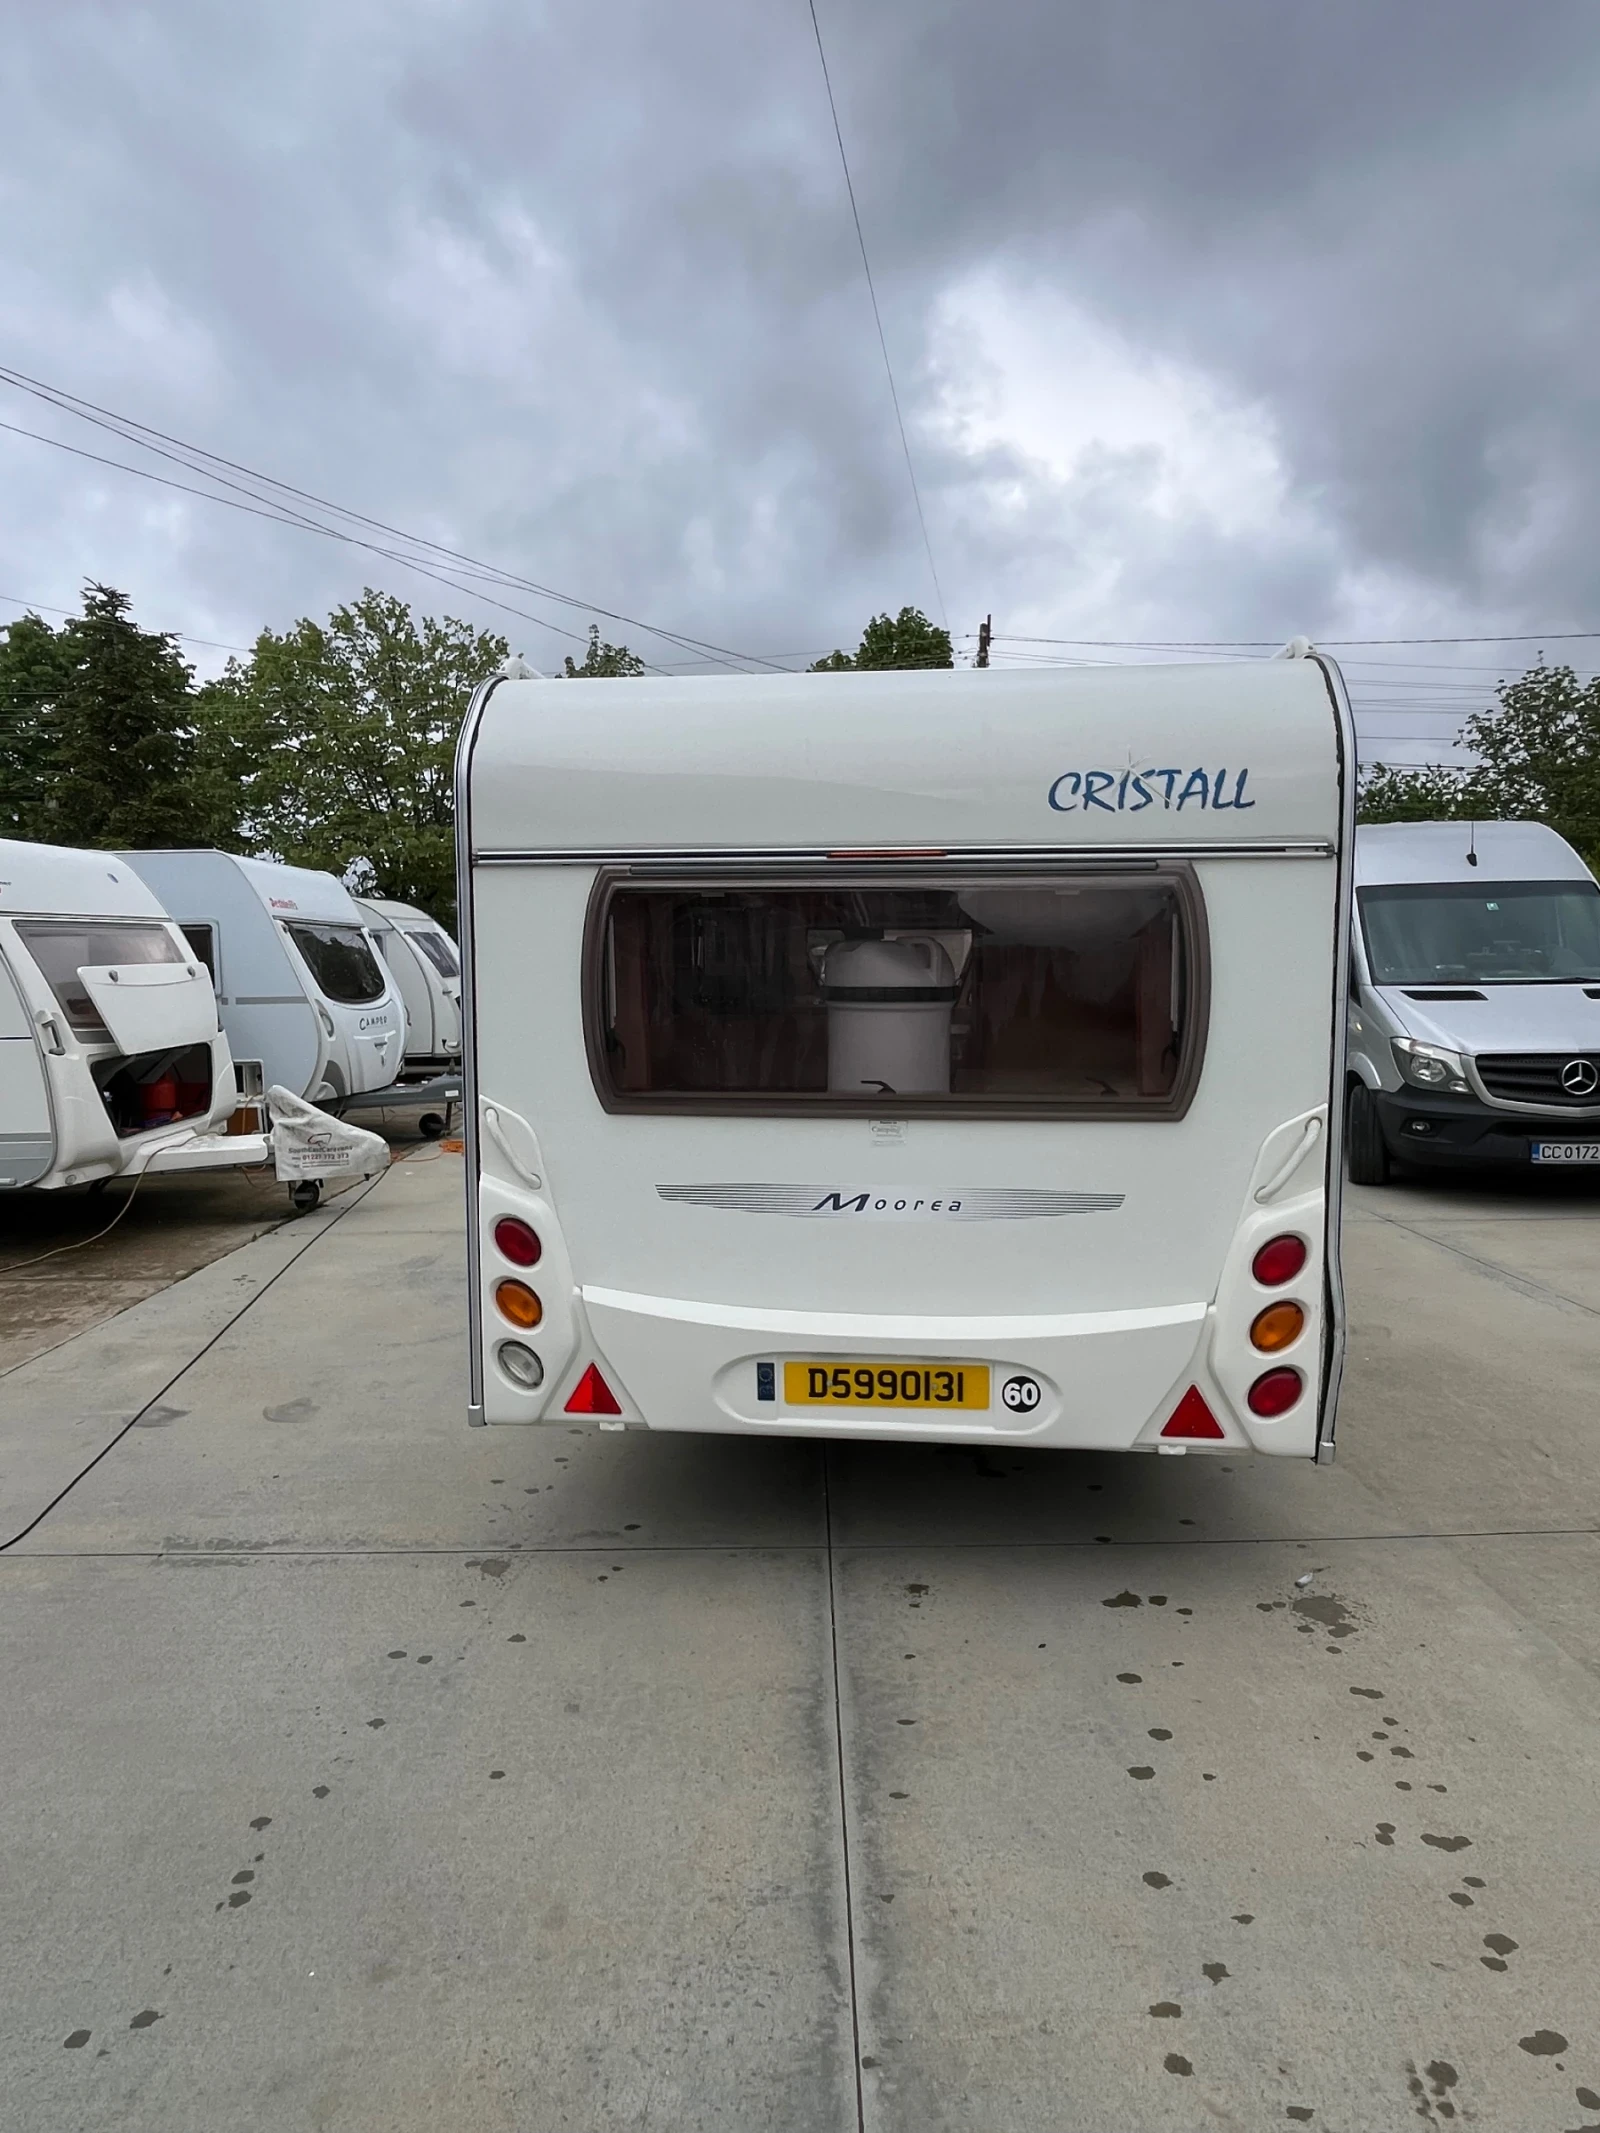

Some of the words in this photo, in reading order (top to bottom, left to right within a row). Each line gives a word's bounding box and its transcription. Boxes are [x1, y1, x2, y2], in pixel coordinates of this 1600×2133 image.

[1048, 767, 1256, 813] CRISTALL
[811, 1193, 962, 1212] Moorea
[808, 1368, 964, 1402] D5990131
[1003, 1382, 1041, 1406] 60
